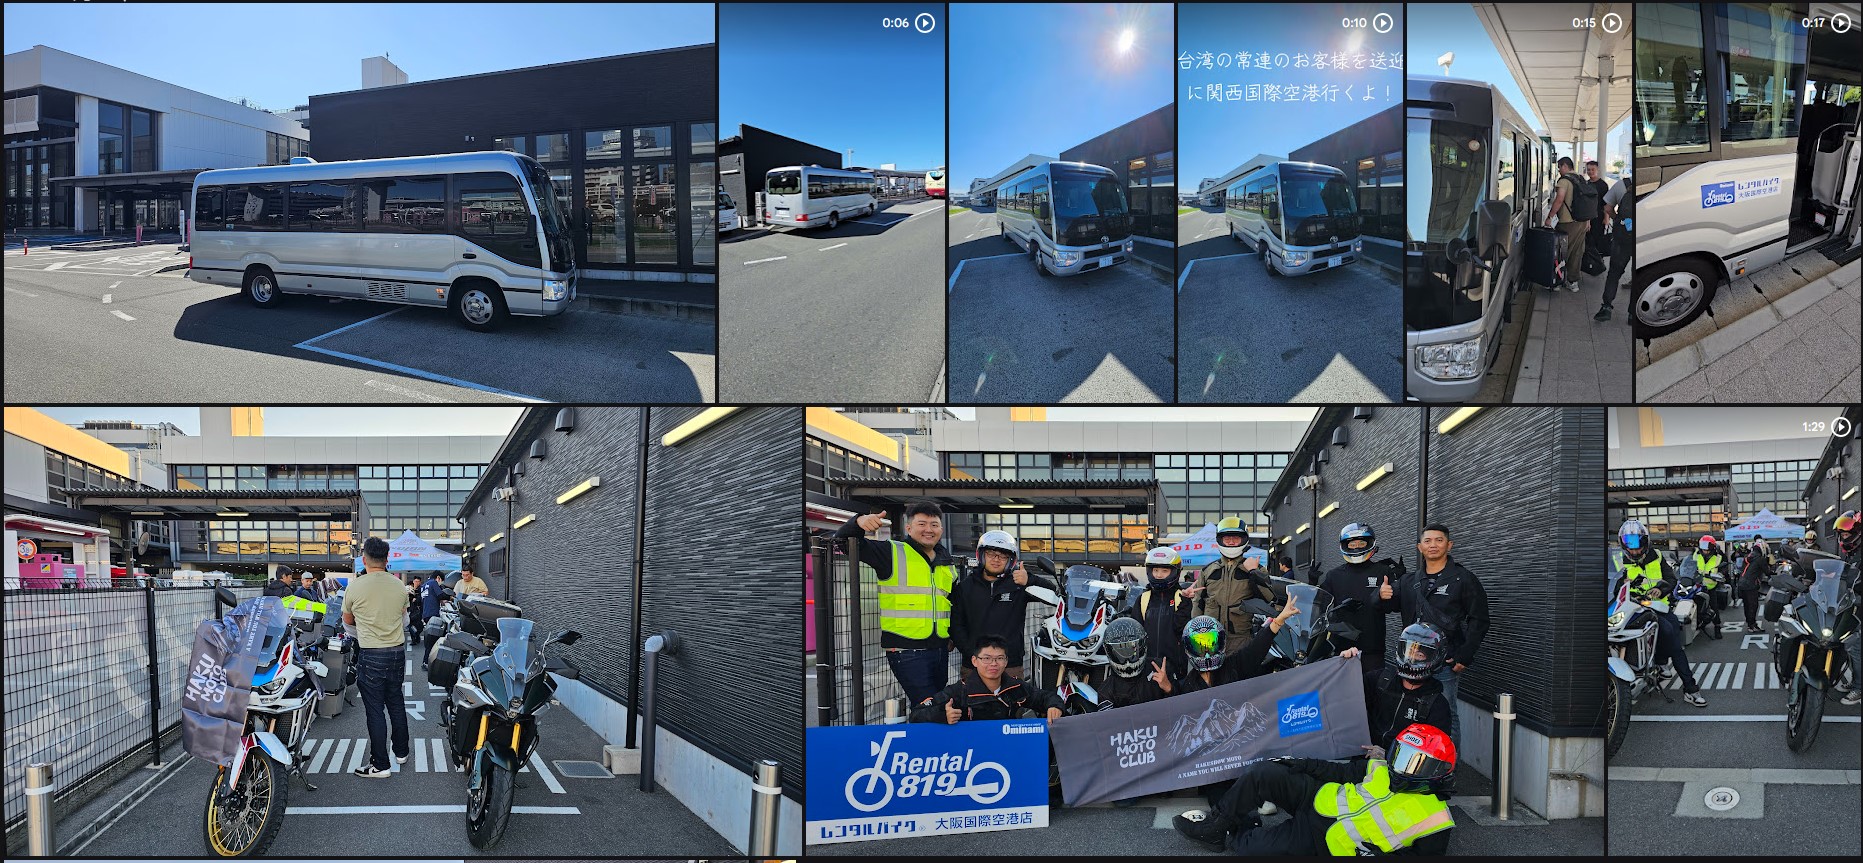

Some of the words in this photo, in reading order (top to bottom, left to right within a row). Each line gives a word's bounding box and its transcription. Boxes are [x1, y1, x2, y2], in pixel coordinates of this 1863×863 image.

[185, 652, 216, 702] HAKU
[200, 664, 222, 702] MOTO
[1002, 723, 1045, 735] Ominami
[1110, 725, 1158, 747] HAKU
[1116, 739, 1156, 757] MOTO
[1119, 752, 1156, 769] CLUB
[890, 748, 974, 776] Rental
[896, 772, 958, 798] 819
[820, 819, 917, 839] レンタルバイク
[935, 811, 1034, 831] 大阪国際空港店
